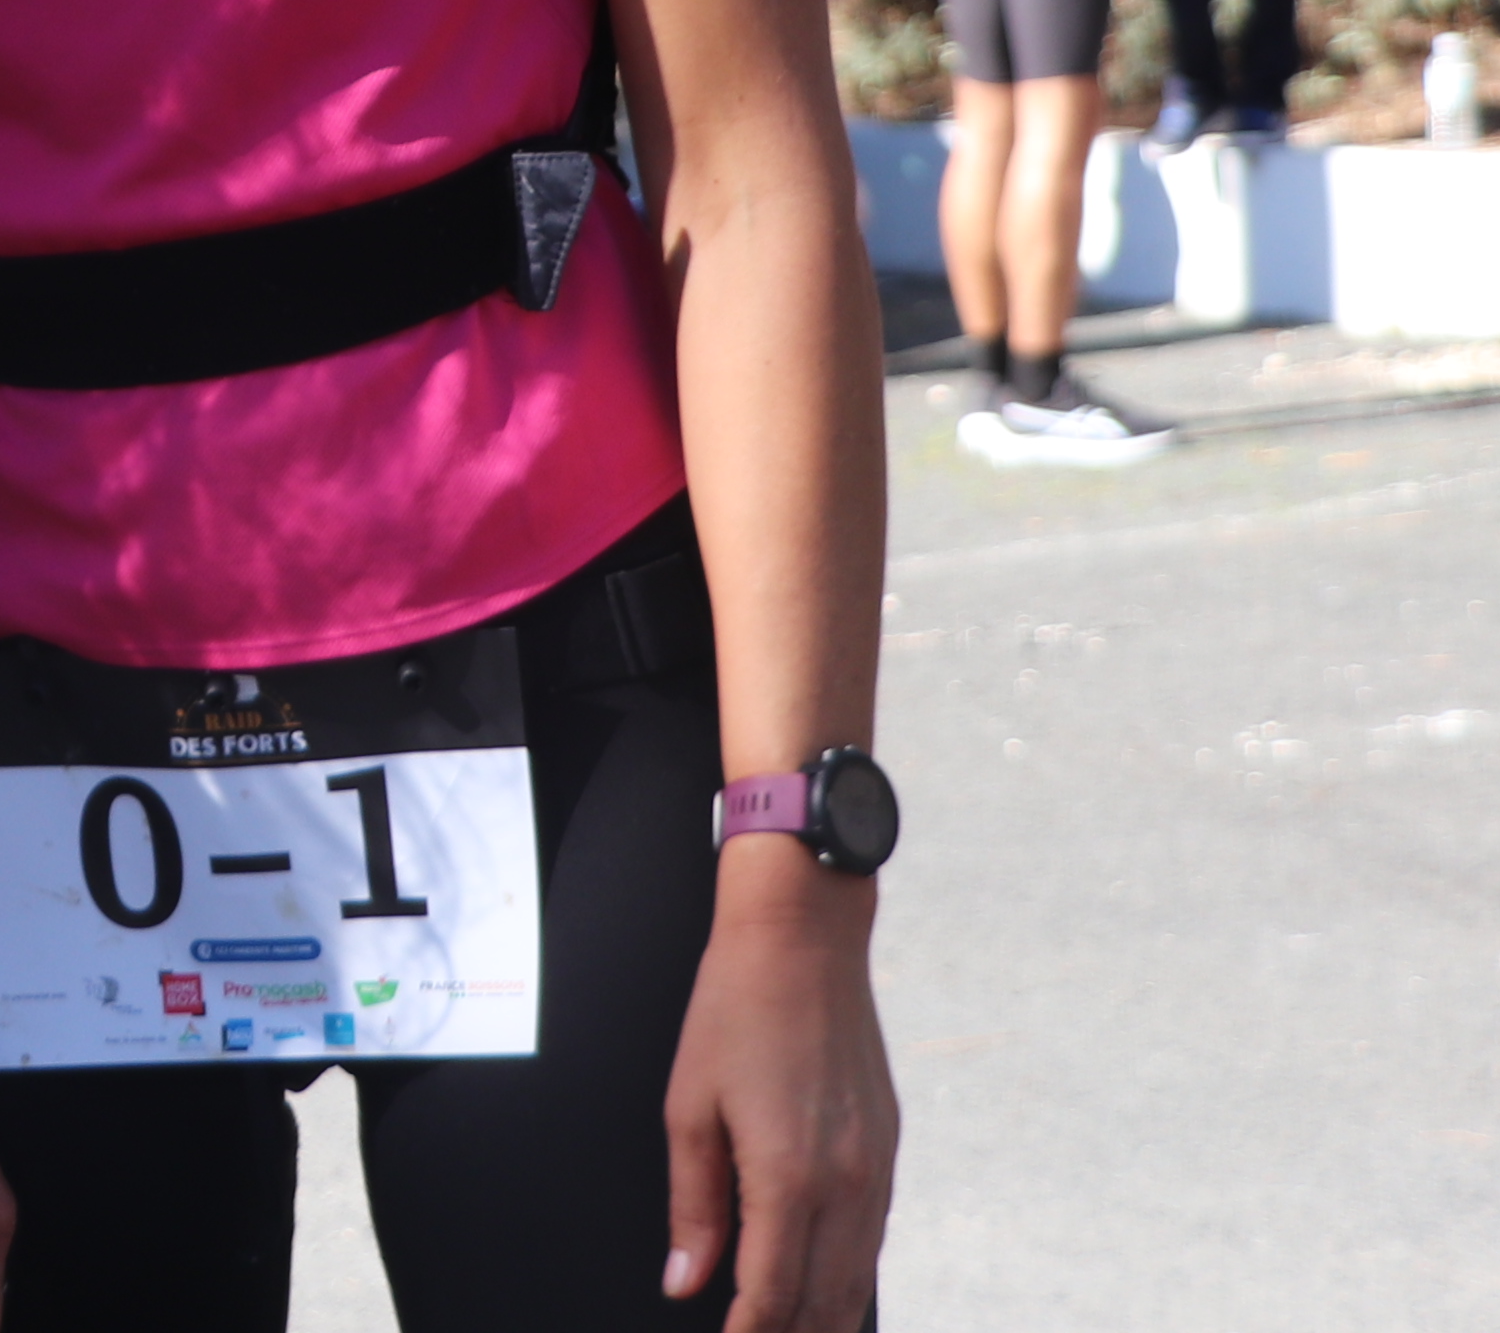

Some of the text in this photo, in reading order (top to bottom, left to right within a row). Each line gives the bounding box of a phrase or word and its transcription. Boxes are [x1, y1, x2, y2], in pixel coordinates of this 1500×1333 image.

[170, 730, 309, 758] DES FORTS
[79, 764, 428, 930] 0-1
